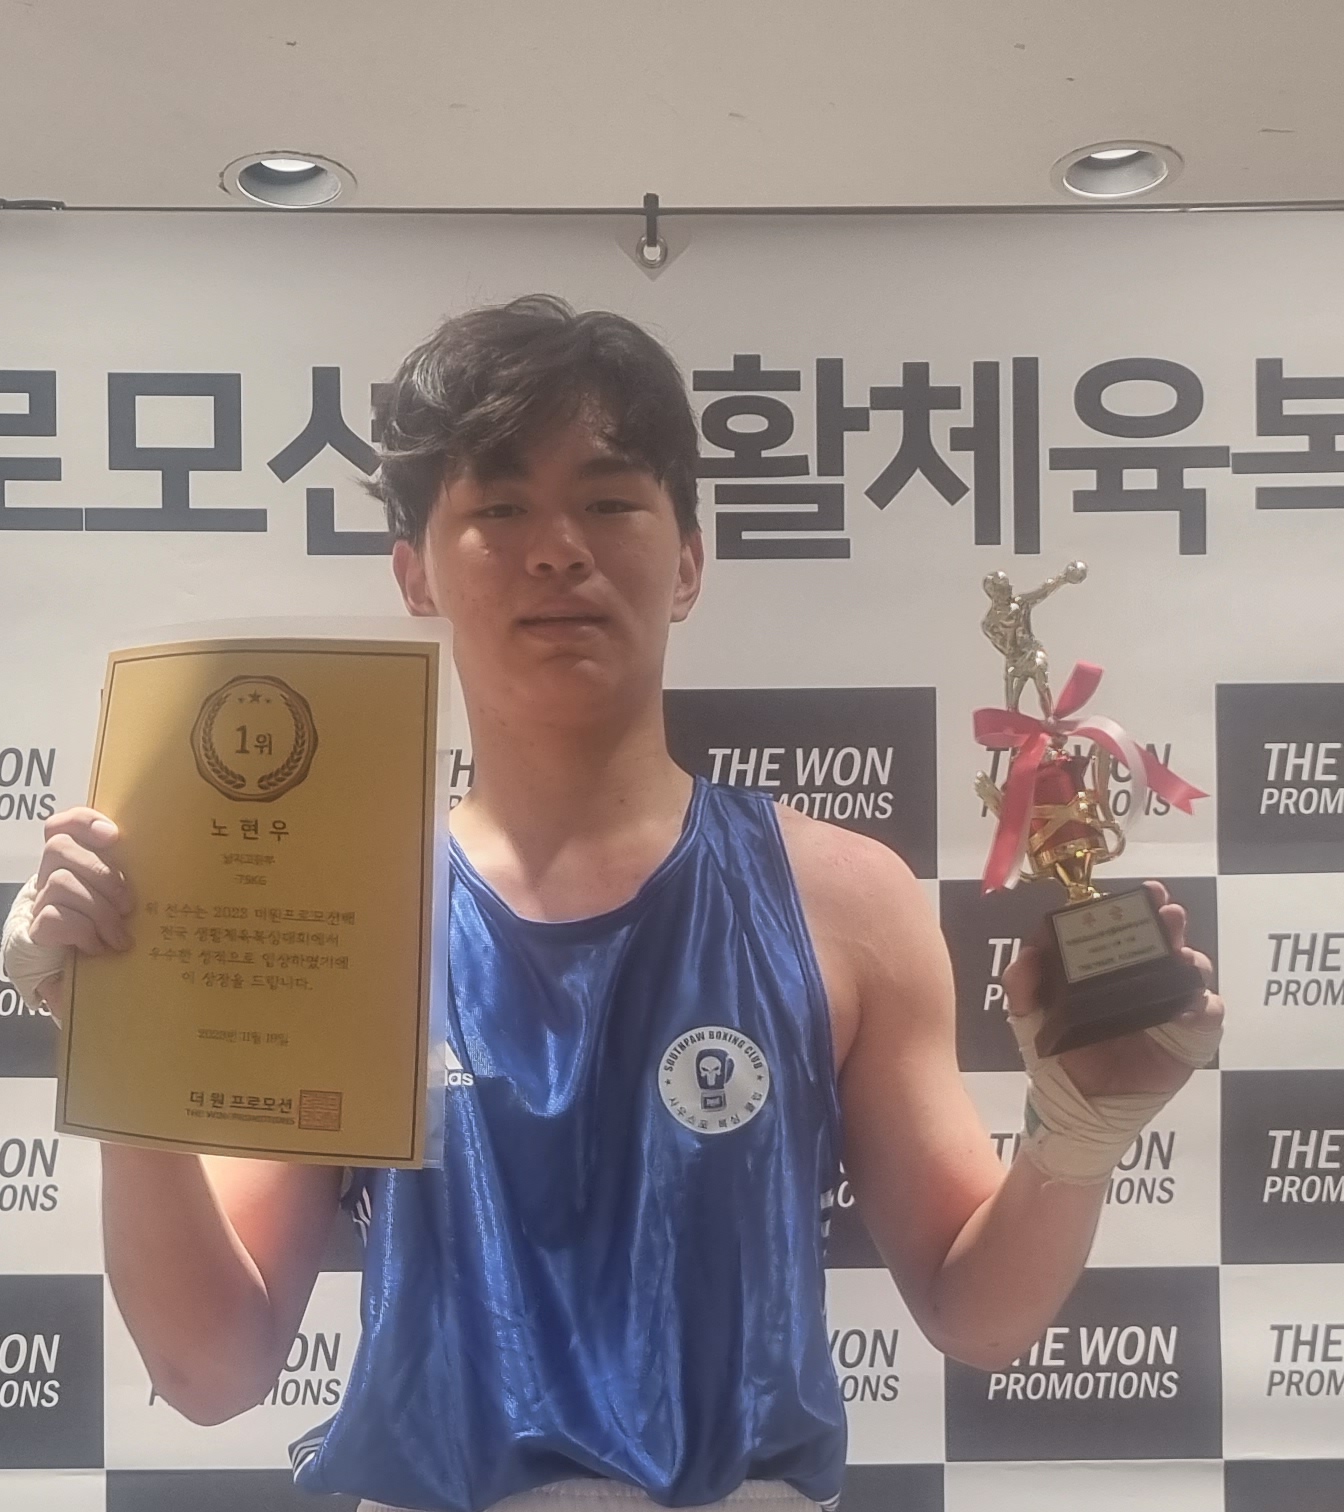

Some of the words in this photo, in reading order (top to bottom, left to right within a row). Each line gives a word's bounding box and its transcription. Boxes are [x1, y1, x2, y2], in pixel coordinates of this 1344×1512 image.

[235, 725, 272, 755] 1위
[198, 950, 255, 965] 성적으로
[202, 971, 244, 989] 상장을
[664, 1031, 706, 1072] SOUTHPAW
[708, 1030, 745, 1048] BOXING
[229, 1095, 293, 1114] 프로모션
